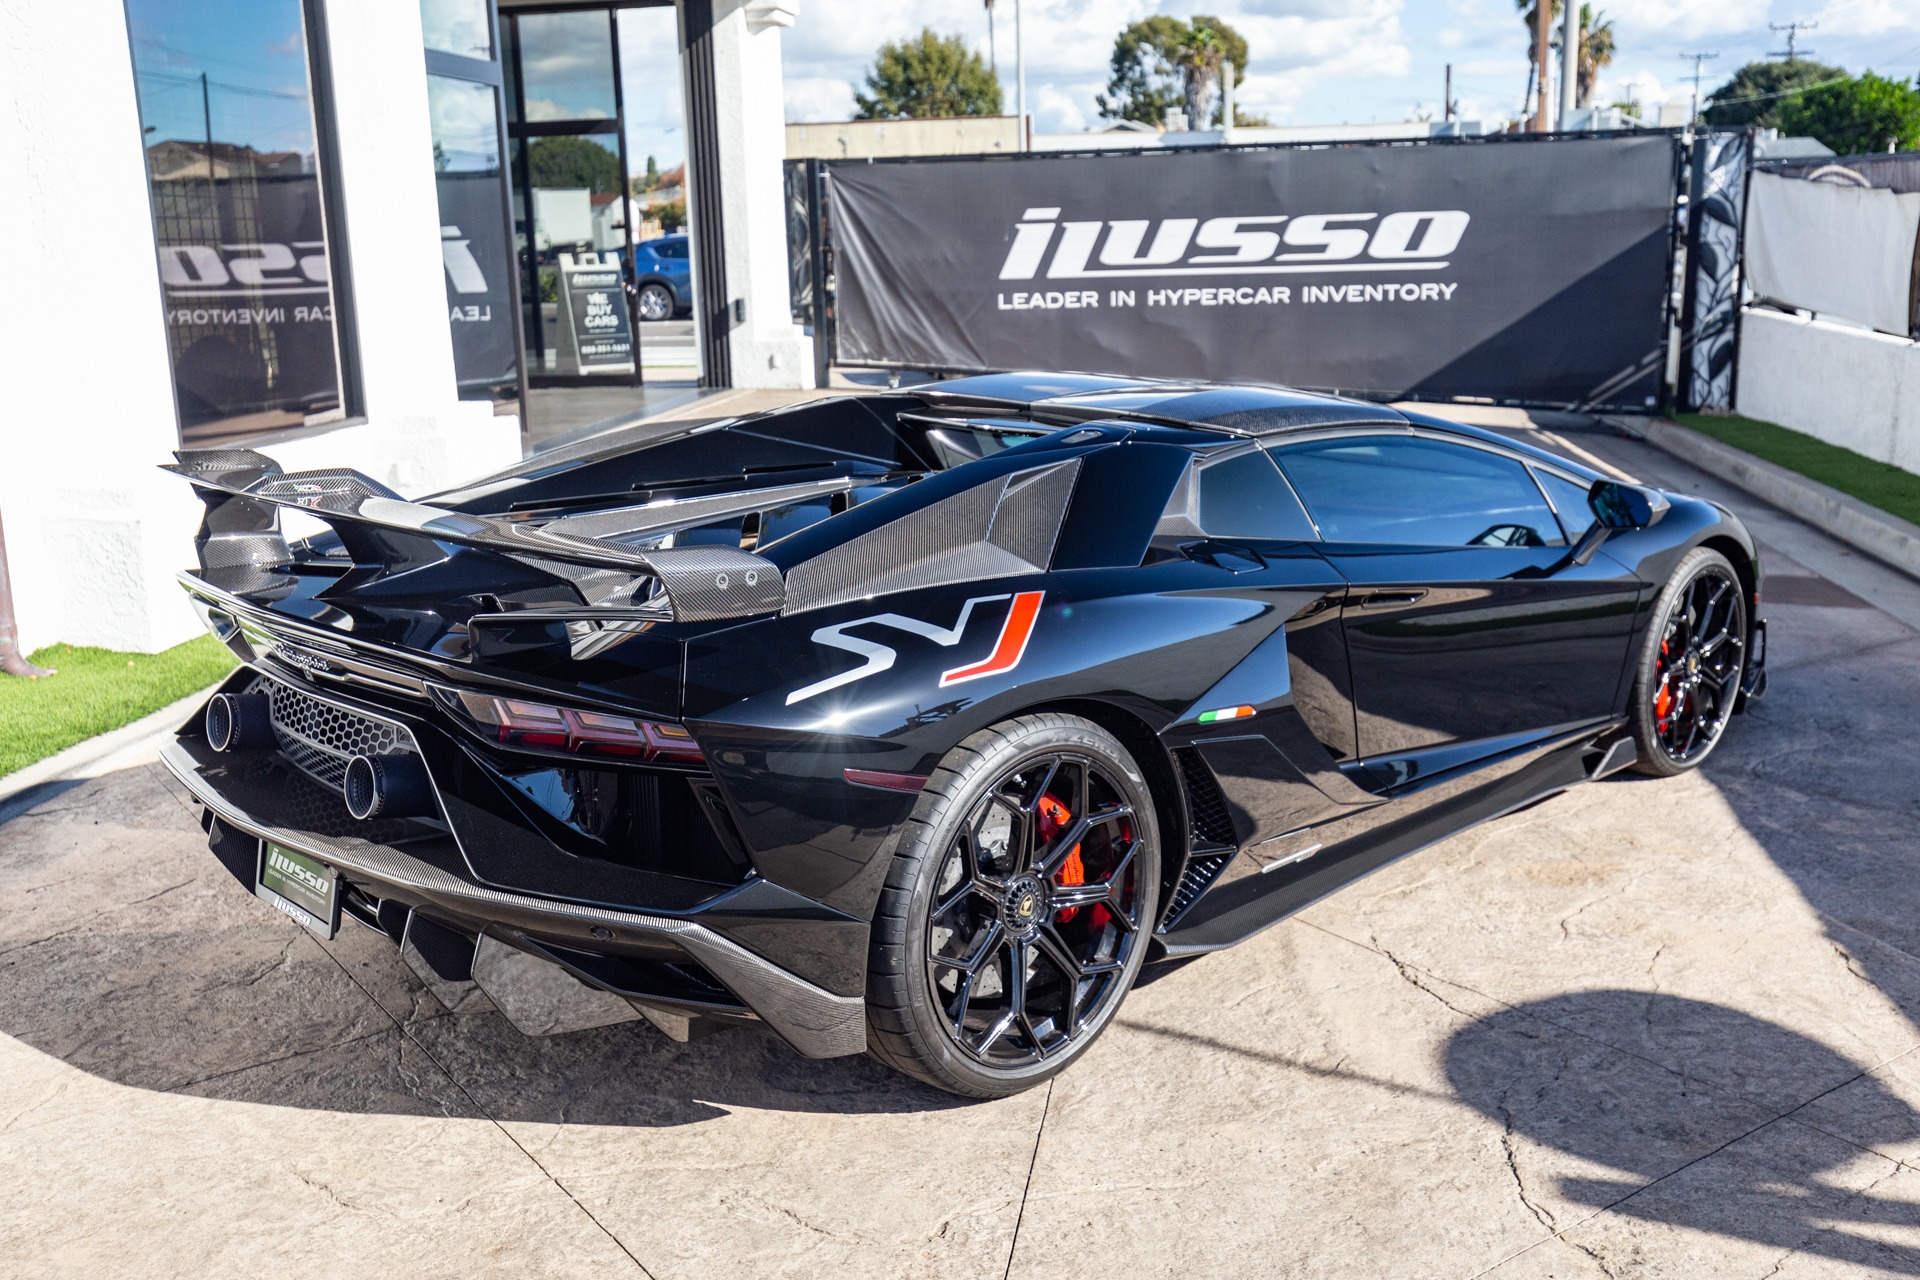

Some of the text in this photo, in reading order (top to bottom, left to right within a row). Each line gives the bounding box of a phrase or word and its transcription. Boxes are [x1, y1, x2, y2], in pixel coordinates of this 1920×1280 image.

[998, 283, 1458, 310] LEADER IN HYPERCAR INVENTORY
[586, 304, 613, 316] BUY
[584, 315, 619, 328] CARS
[785, 590, 1046, 706] SVJ
